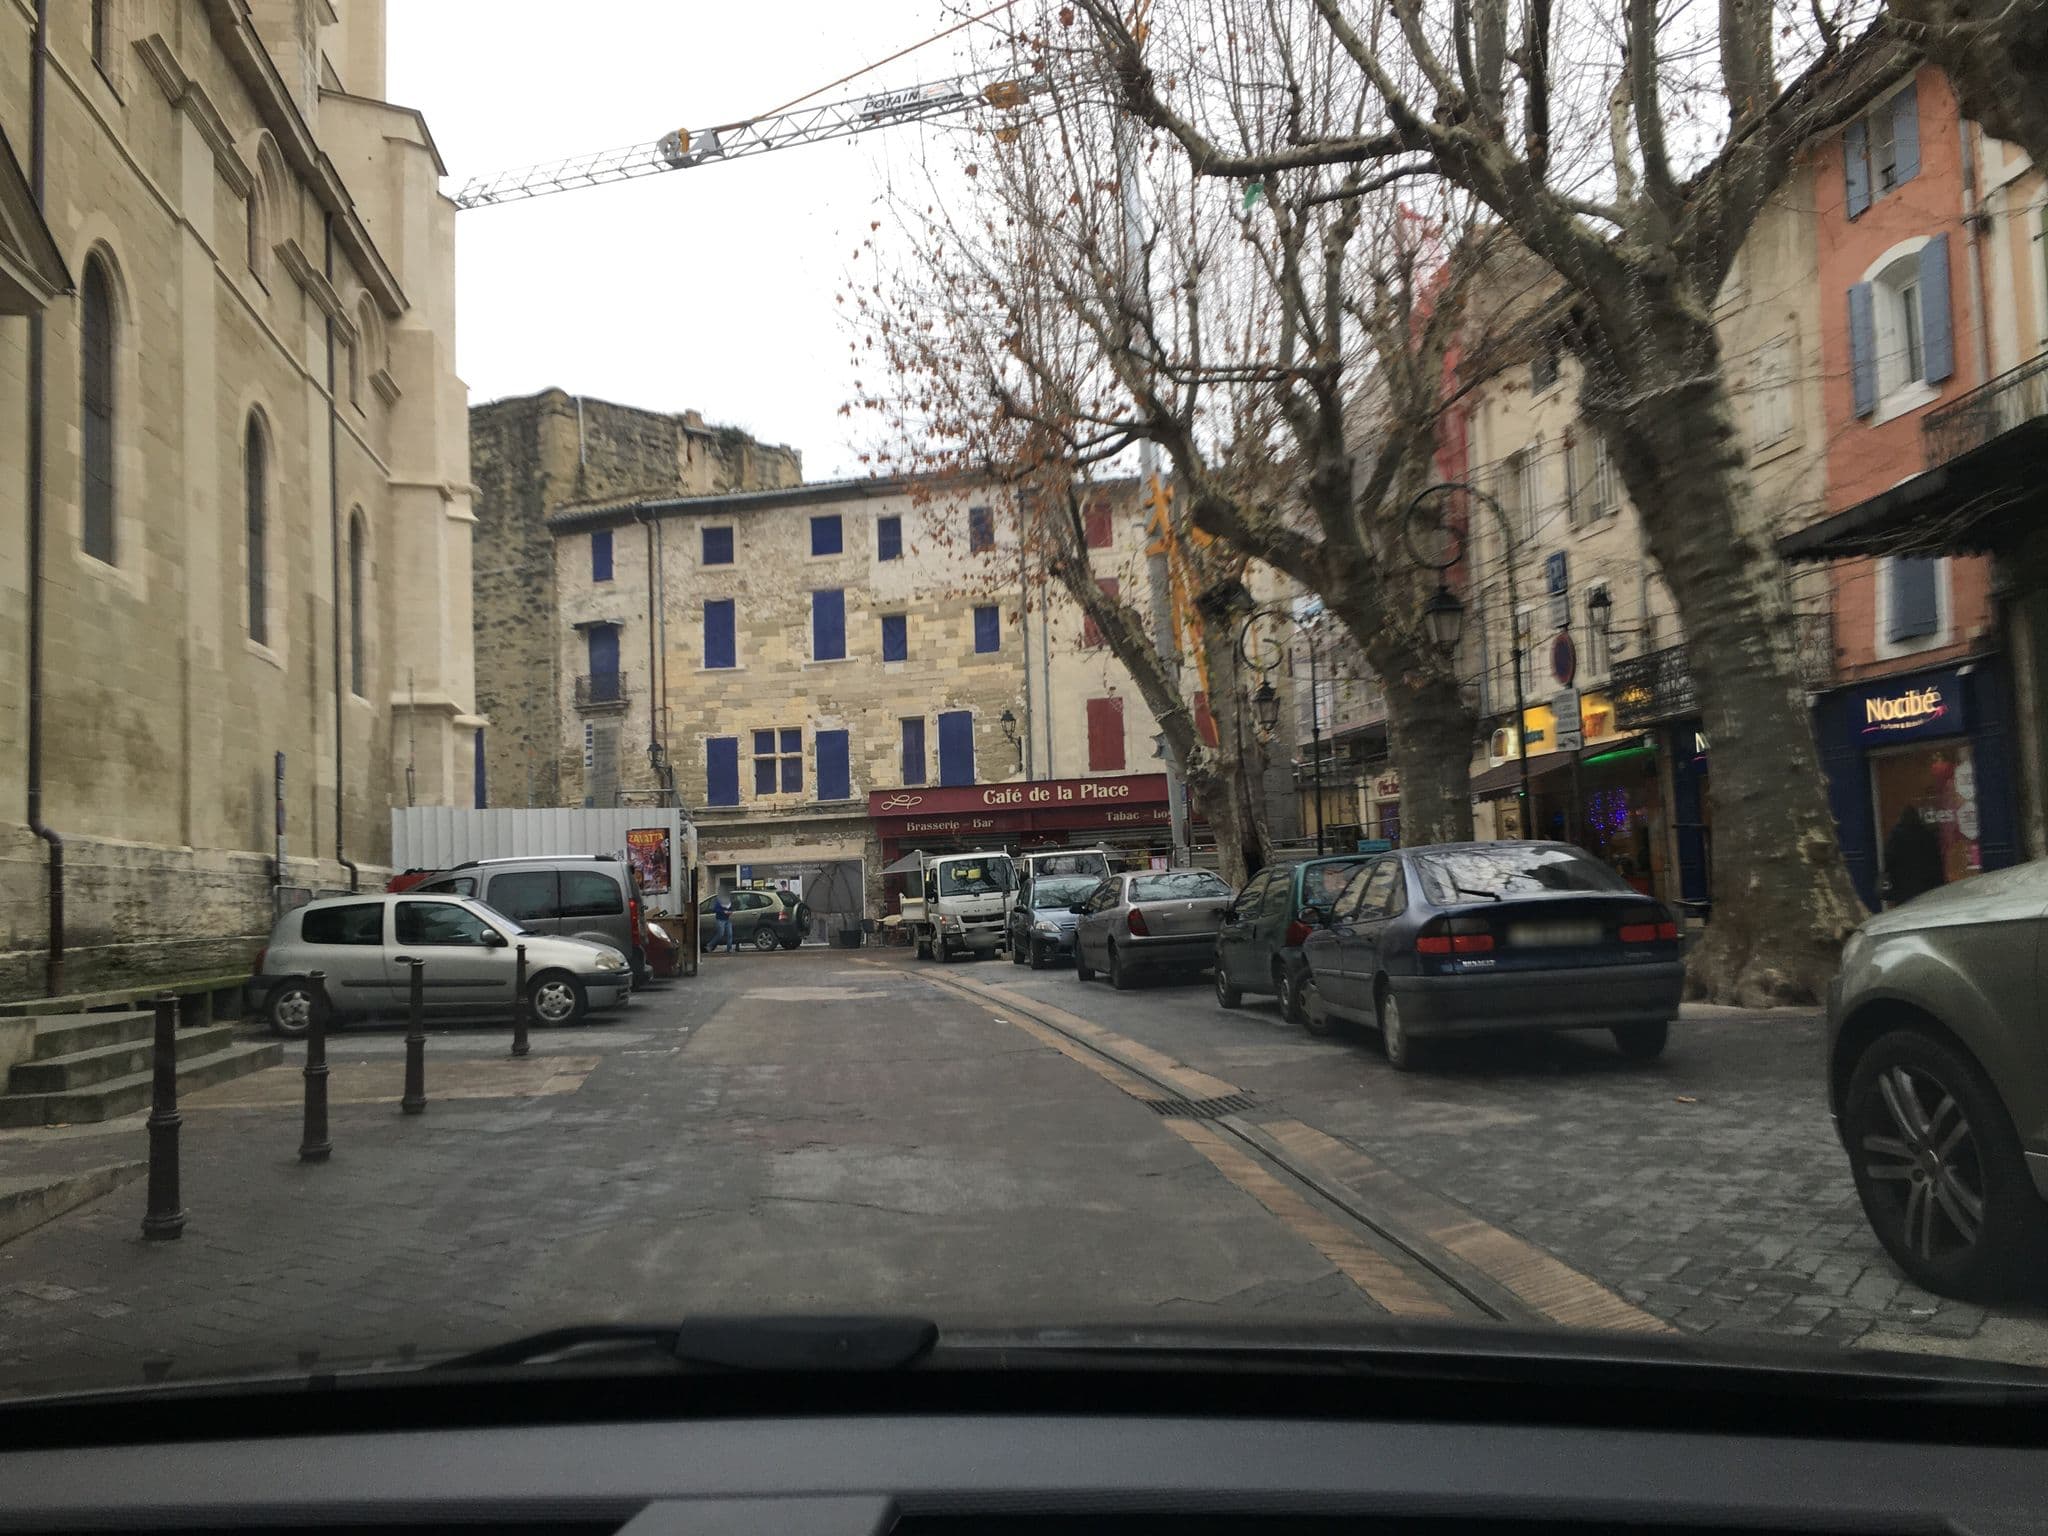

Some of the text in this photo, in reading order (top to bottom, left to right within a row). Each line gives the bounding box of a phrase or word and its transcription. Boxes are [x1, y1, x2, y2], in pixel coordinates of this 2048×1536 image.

[863, 90, 921, 111] POTAIN
[1865, 685, 1942, 723] Nocibé
[983, 783, 1129, 805] Café de la Place
[907, 819, 960, 832] Brasserie
[972, 818, 994, 829] Bar
[1106, 810, 1140, 822] Tabac
